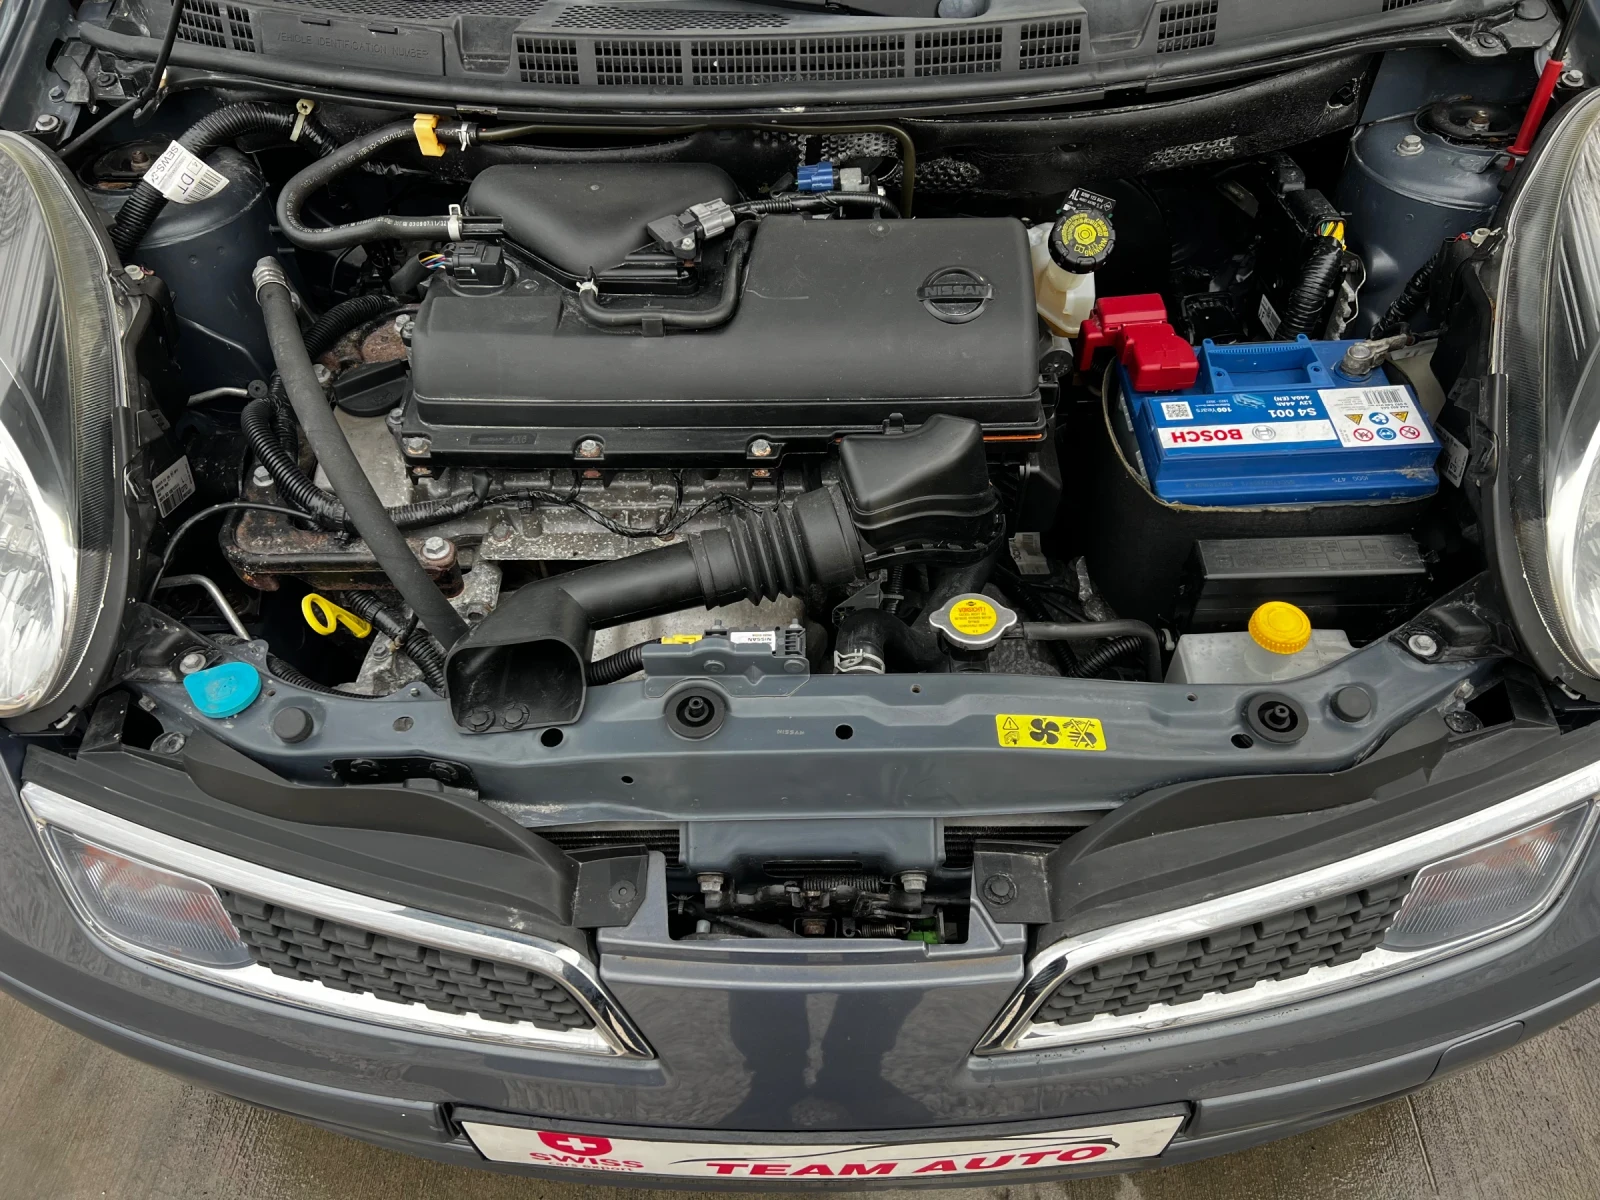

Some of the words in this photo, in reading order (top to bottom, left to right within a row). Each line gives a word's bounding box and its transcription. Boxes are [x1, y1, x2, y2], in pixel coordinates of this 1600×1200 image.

[317, 39, 387, 55] IDENTIFICATION
[392, 48, 429, 59] NUMBER
[177, 172, 195, 195] DT
[1069, 189, 1079, 201] AL
[924, 285, 987, 297] NISSAN
[1267, 408, 1295, 418] 001
[1297, 407, 1317, 417] S4
[1171, 429, 1243, 443] BOSCH
[529, 1152, 644, 1168] SWISS
[706, 1162, 898, 1176] TEAM
[911, 1145, 1108, 1174] AUTO
[582, 1164, 634, 1172] export
